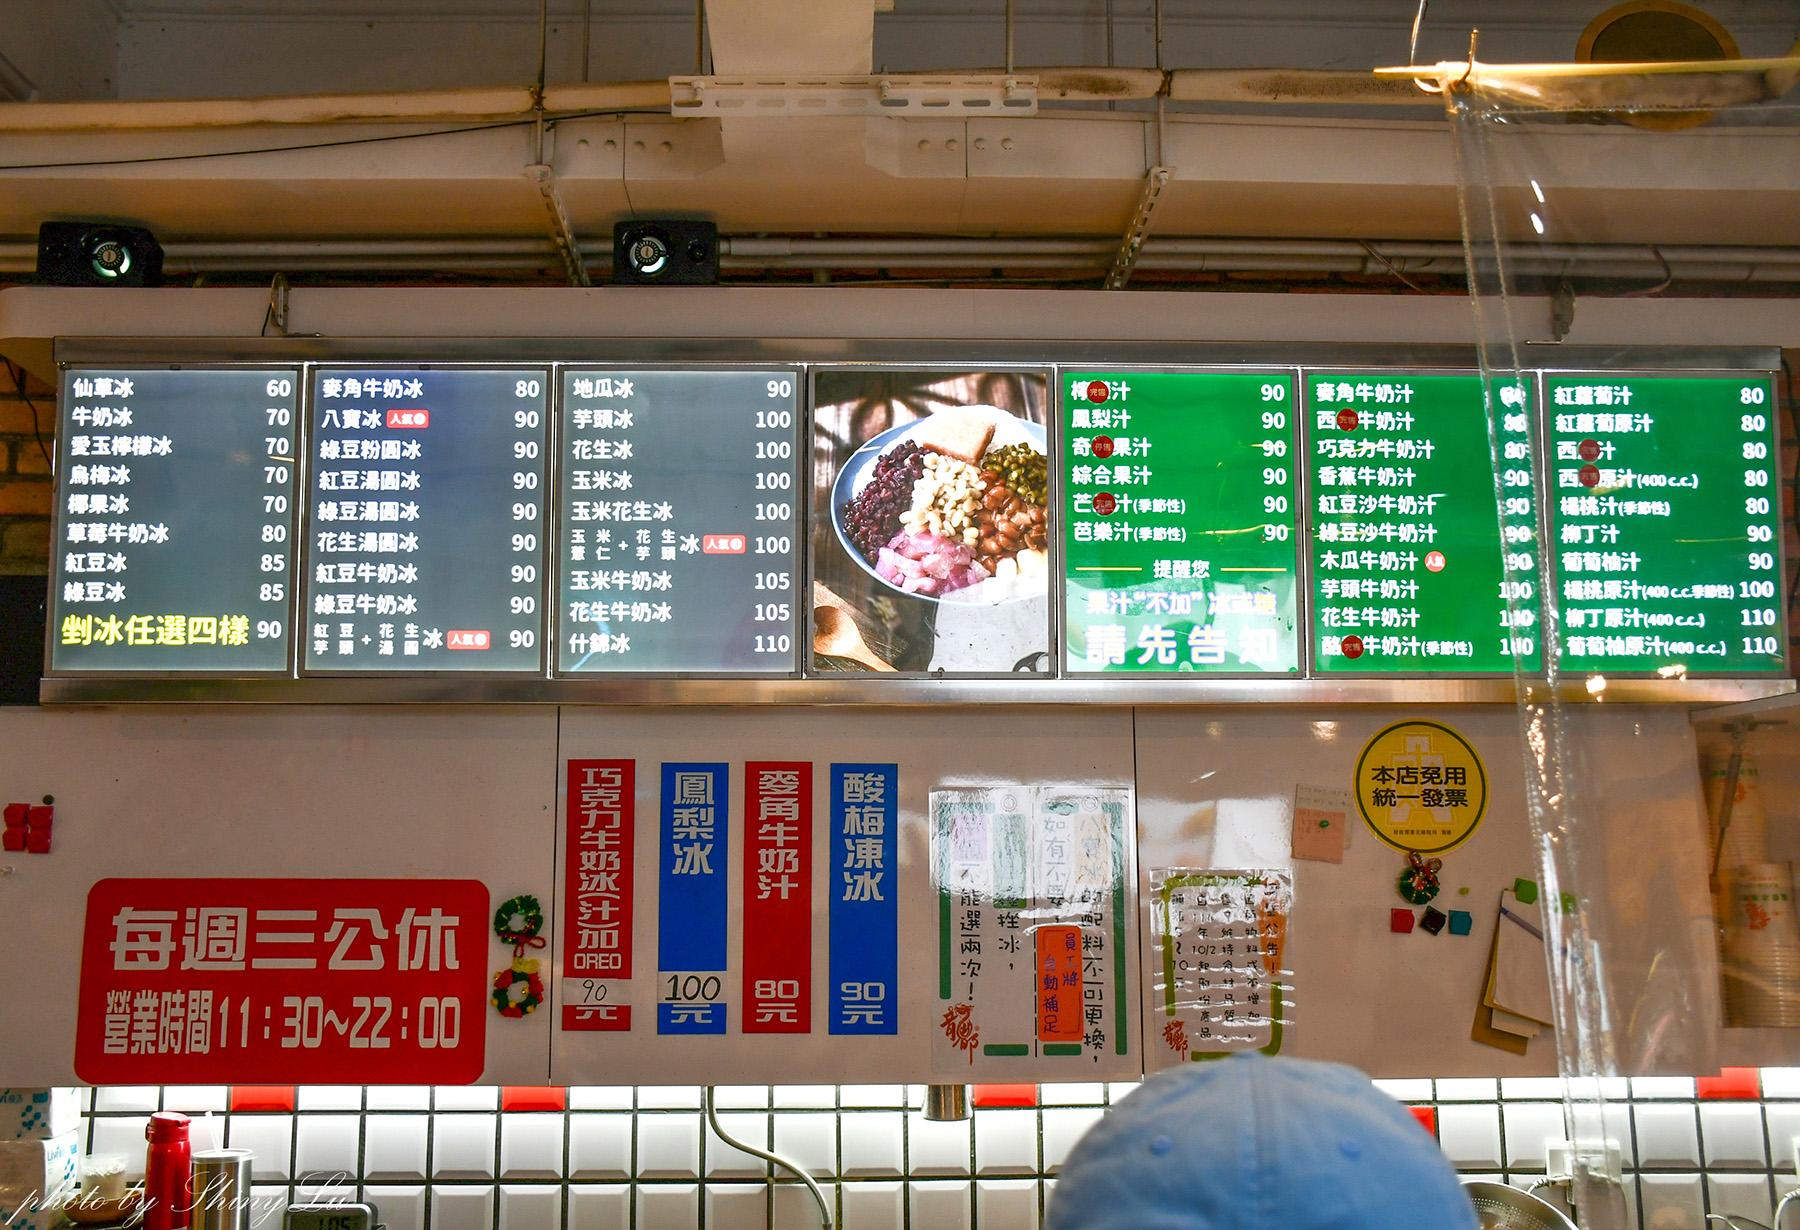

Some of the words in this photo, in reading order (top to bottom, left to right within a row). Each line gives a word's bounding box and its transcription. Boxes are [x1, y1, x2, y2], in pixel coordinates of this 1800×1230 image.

[73, 378, 134, 398] 仙草冰
[267, 379, 291, 397] 60
[323, 378, 423, 398] 麥角牛奶冰
[515, 380, 539, 397] 80
[573, 378, 634, 399] 地瓜冰
[767, 380, 791, 398] 90
[1071, 381, 1131, 402] 檸汁
[1261, 385, 1284, 401] 90
[1316, 382, 1414, 403] 麥角牛奶汁
[1741, 388, 1763, 404] 80
[72, 406, 132, 427] 牛奶冰
[266, 408, 290, 425] 70
[322, 409, 381, 429] 八寶冰
[515, 411, 539, 428] 90
[573, 409, 633, 429] 芋頭冰
[756, 411, 791, 428] 100
[1072, 409, 1131, 428] 鳳梨汁
[1262, 412, 1285, 428] 90
[1317, 410, 1414, 431] 西牛奶汁
[1741, 415, 1765, 431] 80
[71, 436, 172, 456] 愛玉檸檬冰
[265, 438, 289, 454] 70
[320, 440, 421, 459] 綠豆粉圓冰
[514, 442, 538, 458] 90
[572, 439, 633, 460] 花生冰
[756, 442, 790, 459] 100
[1072, 436, 1151, 457] 奇果汁
[1262, 440, 1286, 457] 90
[1317, 438, 1435, 459] 巧克力牛奶汁
[1504, 441, 1525, 460] 80
[1557, 441, 1616, 460] 西汁
[1743, 443, 1766, 459] 80
[69, 464, 130, 485] 烏梅冰
[264, 467, 288, 483] 70
[319, 470, 420, 490] 紅豆湯圓冰
[513, 472, 537, 489] 90
[572, 470, 632, 490] 玉米冰
[756, 472, 790, 489] 100
[1072, 465, 1152, 485] 綜合果汁
[1263, 468, 1286, 484] 90
[1318, 466, 1416, 486] 香蕉牛奶汁
[1504, 469, 1529, 487] 90
[1745, 470, 1767, 486] 80
[68, 494, 129, 514] 椰果冰
[263, 496, 287, 513] 70
[318, 501, 419, 521] 綠豆湯圓冰
[513, 503, 537, 520] 90
[571, 501, 673, 521] 玉米花生冰
[755, 503, 790, 520] 100
[1073, 493, 1185, 515] 芒汁(季節性)
[1264, 496, 1287, 512] 90
[1319, 494, 1437, 515] 紅豆沙牛奶汁
[1506, 497, 1530, 515] 90
[1746, 498, 1769, 514] 80
[67, 522, 169, 543] 草莓牛奶冰
[262, 525, 286, 542] 80
[317, 532, 419, 552] 花生湯圓冰
[512, 534, 536, 551] 90
[1264, 524, 1288, 542] 90
[1319, 522, 1437, 543] 綠豆沙牛奶汁
[1505, 525, 1531, 543] 90
[1561, 524, 1620, 543] 柳丁汁
[1748, 526, 1772, 542] 90
[755, 536, 790, 554] 100
[65, 552, 127, 573] 紅豆冰
[261, 554, 284, 571] 85
[1153, 559, 1210, 579] 提醒您
[1320, 550, 1418, 571] 木瓜牛奶汁
[1508, 553, 1534, 571] 90
[1562, 552, 1641, 571] 葡萄柚汁
[1749, 553, 1773, 569] 90
[316, 562, 418, 583] 紅豆牛奶冰
[511, 565, 535, 582] 90
[570, 570, 672, 591] 玉米牛奶冰
[755, 573, 790, 590] 105
[64, 582, 125, 602] 綠豆冰
[260, 584, 284, 601] 85
[1321, 579, 1419, 599] 芋頭牛奶汁
[1740, 581, 1774, 597] 100
[315, 593, 417, 615] 綠豆牛奶冰
[511, 596, 535, 614] 90
[569, 601, 672, 624] 花生牛奶冰
[755, 604, 790, 621] 105
[1321, 607, 1420, 627] 花生牛奶汁
[1741, 609, 1775, 625] 110
[257, 621, 281, 638] 90
[510, 630, 534, 647] 90
[754, 635, 791, 652] 110
[1322, 635, 1473, 657] 酪牛奶汁(季節性)
[1743, 637, 1777, 655] 110
[1371, 765, 1467, 786] 本店免用
[1372, 787, 1469, 808] 統一發票
[672, 771, 715, 875] 鳳梨冰
[842, 772, 885, 902] 酸梅凍冰
[109, 906, 460, 971] 每週三公休
[574, 953, 622, 970] OREO
[582, 979, 607, 1004] 90
[665, 974, 721, 1001] 100
[754, 979, 799, 999] 80
[840, 982, 885, 1001] 90
[670, 1004, 712, 1024] 元
[756, 1003, 798, 1023] 元
[842, 1004, 884, 1025] 元
